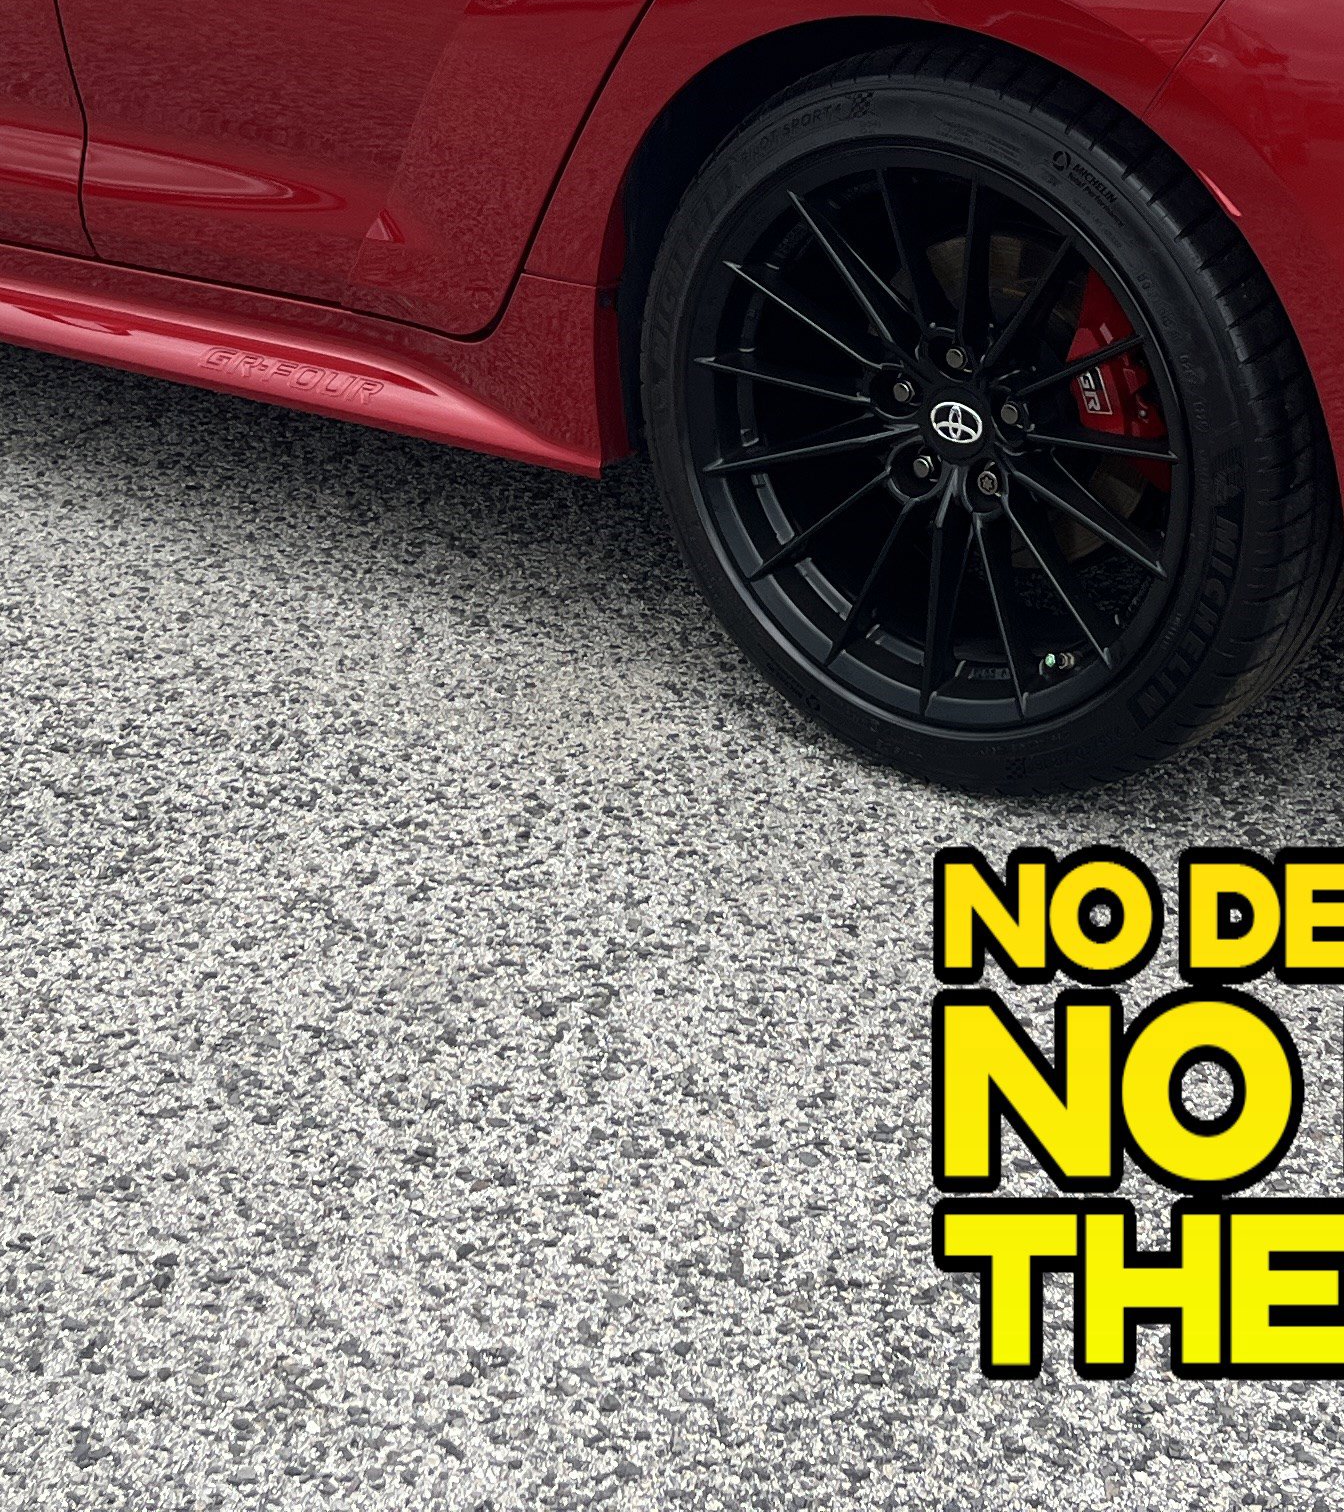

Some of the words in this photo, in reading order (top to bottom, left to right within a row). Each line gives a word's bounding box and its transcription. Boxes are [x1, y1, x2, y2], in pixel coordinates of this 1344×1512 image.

[782, 103, 833, 136] SPORT
[1073, 163, 1118, 204] MICHELIN
[1079, 371, 1101, 411] GR
[1136, 514, 1240, 720] MICHELIN
